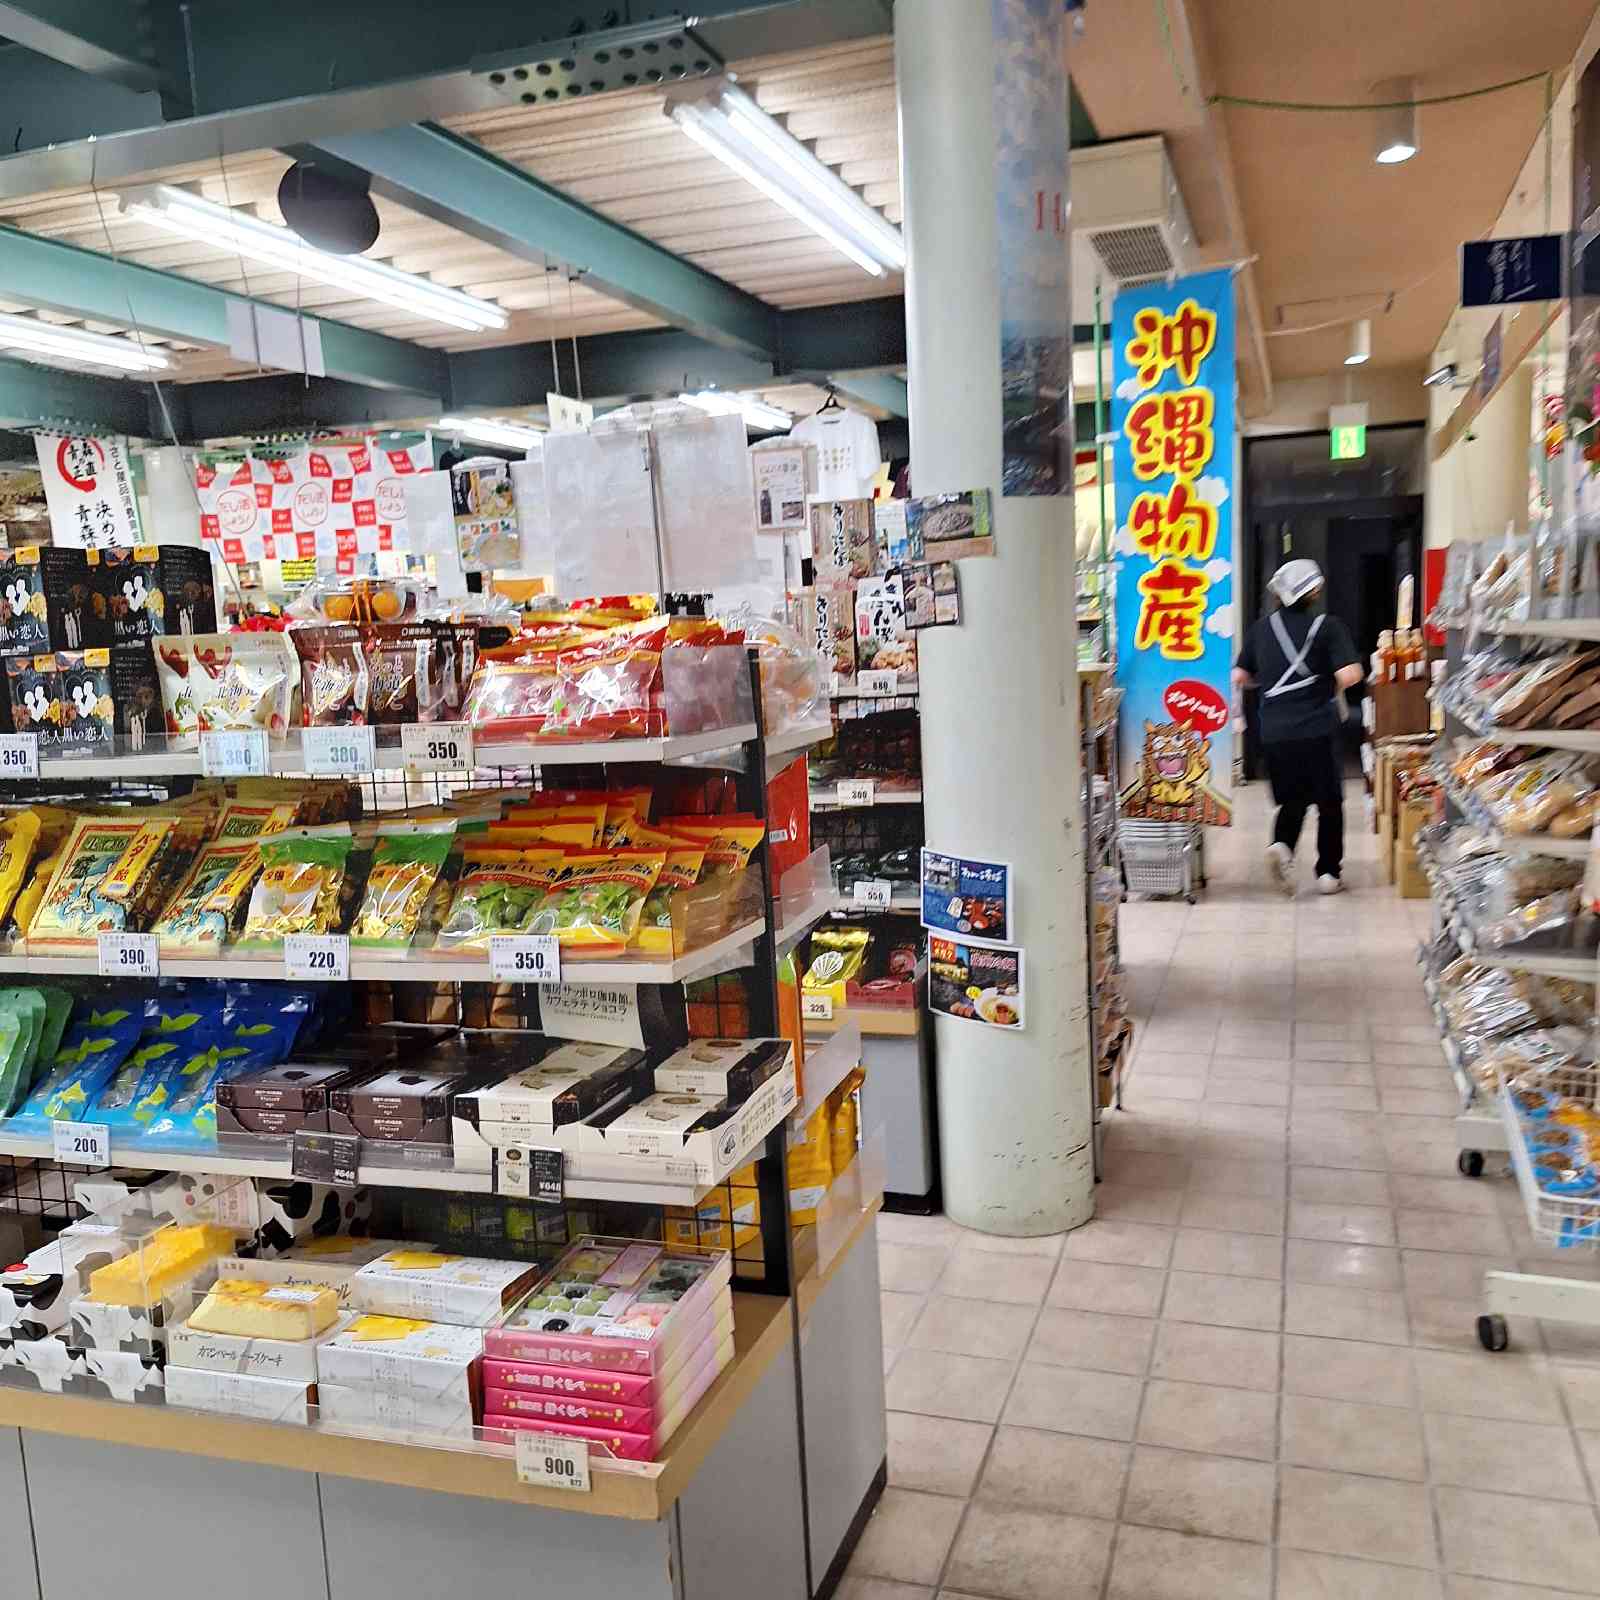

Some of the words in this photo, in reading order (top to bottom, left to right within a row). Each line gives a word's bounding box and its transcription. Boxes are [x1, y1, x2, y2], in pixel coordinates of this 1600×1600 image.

[1126, 299, 1218, 660] 沖縄物産
[3, 750, 27, 766] 350
[428, 742, 458, 759] 350
[120, 949, 145, 965] 390
[309, 952, 335, 969] 220
[515, 952, 544, 970] 350
[74, 1138, 97, 1153] 200
[545, 1457, 574, 1476] 900
